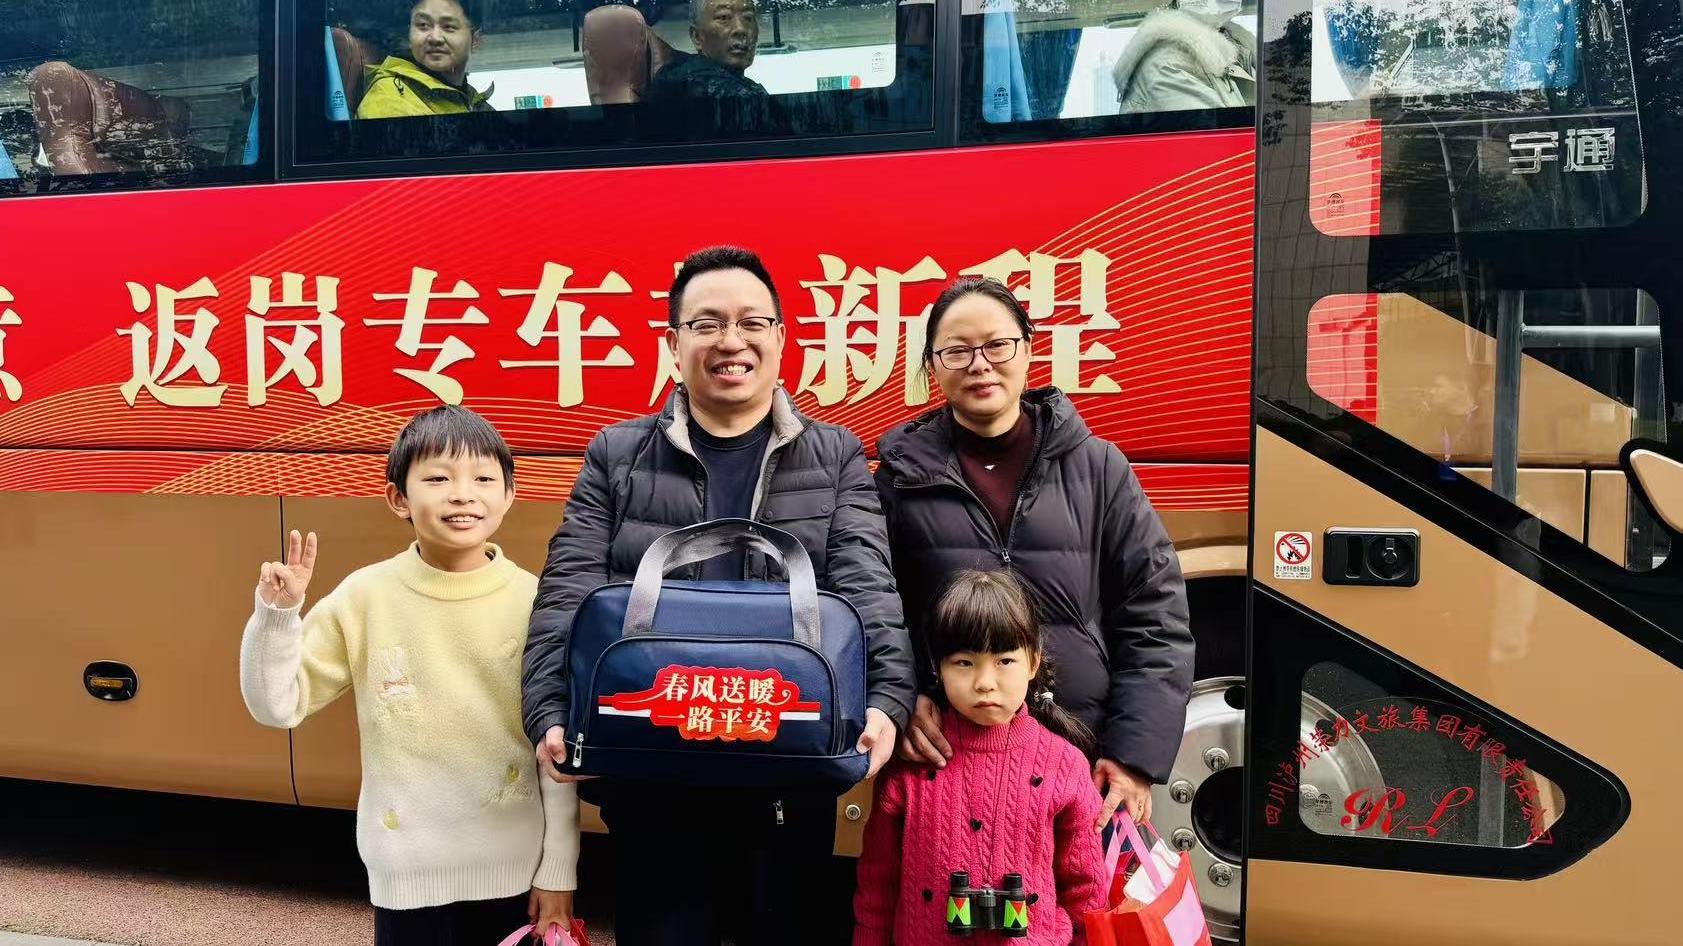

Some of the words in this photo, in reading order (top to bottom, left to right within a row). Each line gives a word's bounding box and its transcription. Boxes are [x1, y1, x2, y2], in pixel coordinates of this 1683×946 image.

[1508, 127, 1616, 175] 宇通
[116, 248, 1122, 408] 返岗专车新程
[661, 672, 777, 705] 春风送暖
[657, 704, 773, 735] 一路平安
